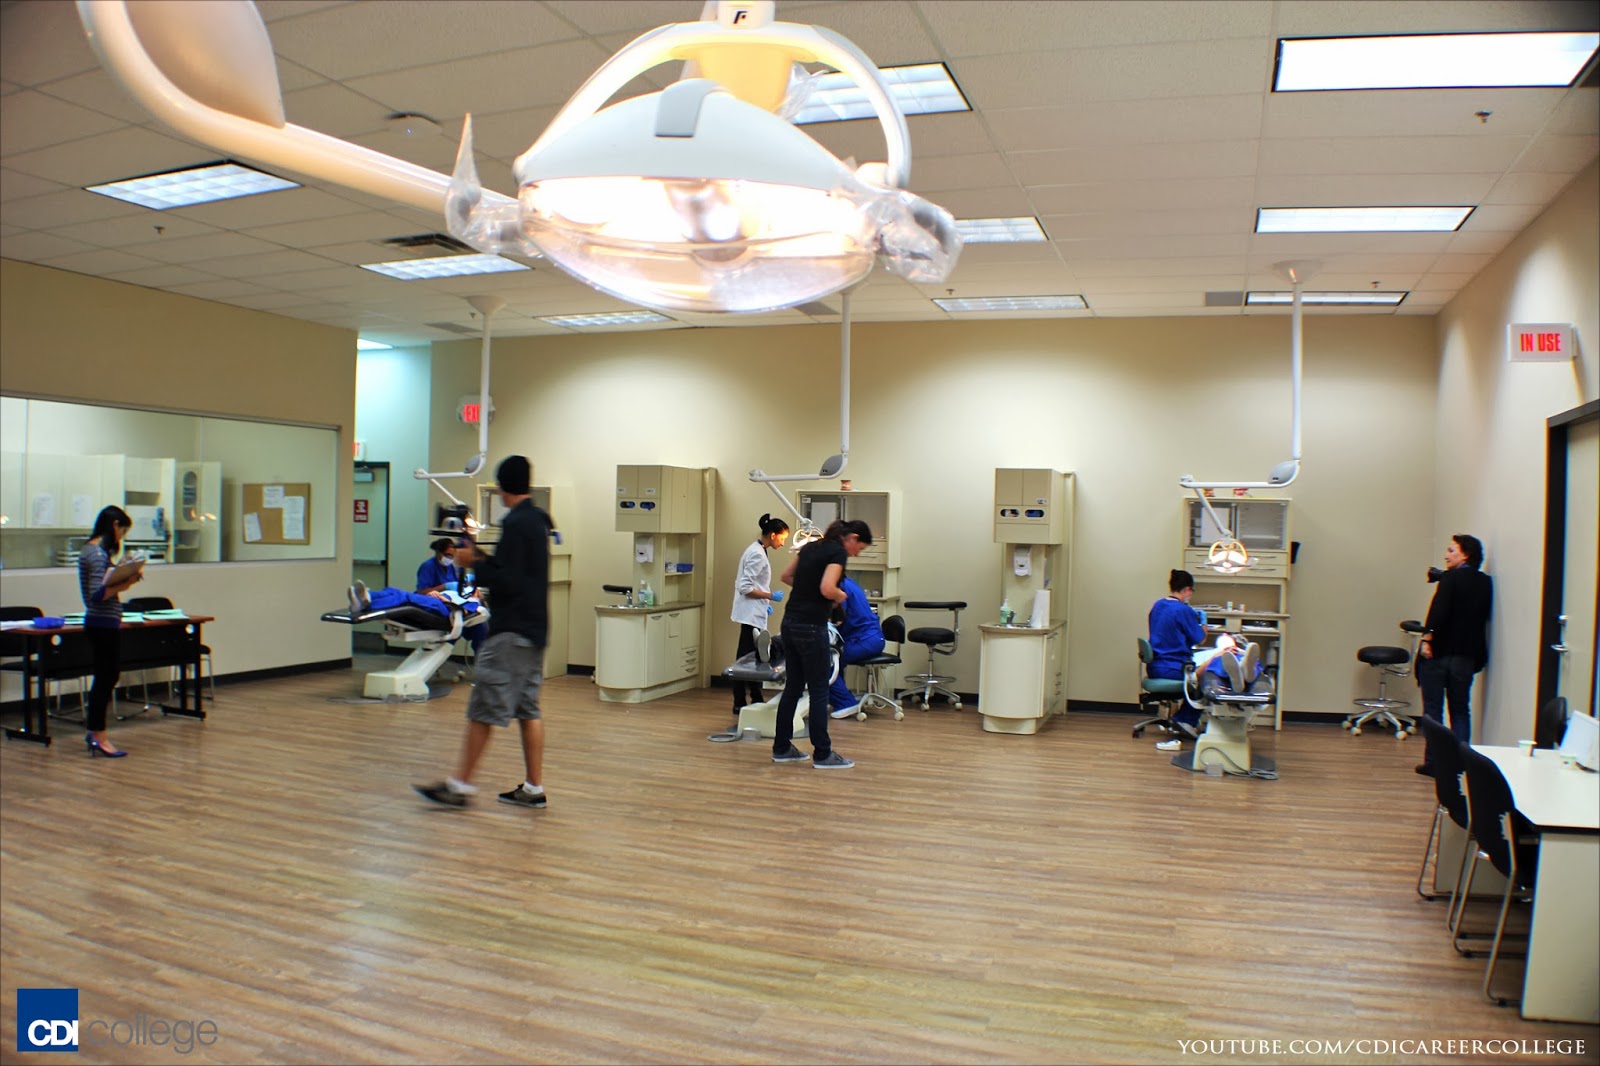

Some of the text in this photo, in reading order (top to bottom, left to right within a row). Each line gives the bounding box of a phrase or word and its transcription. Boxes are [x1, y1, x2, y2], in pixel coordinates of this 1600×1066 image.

[1520, 333, 1561, 352] IN USE
[463, 404, 481, 422] EXI
